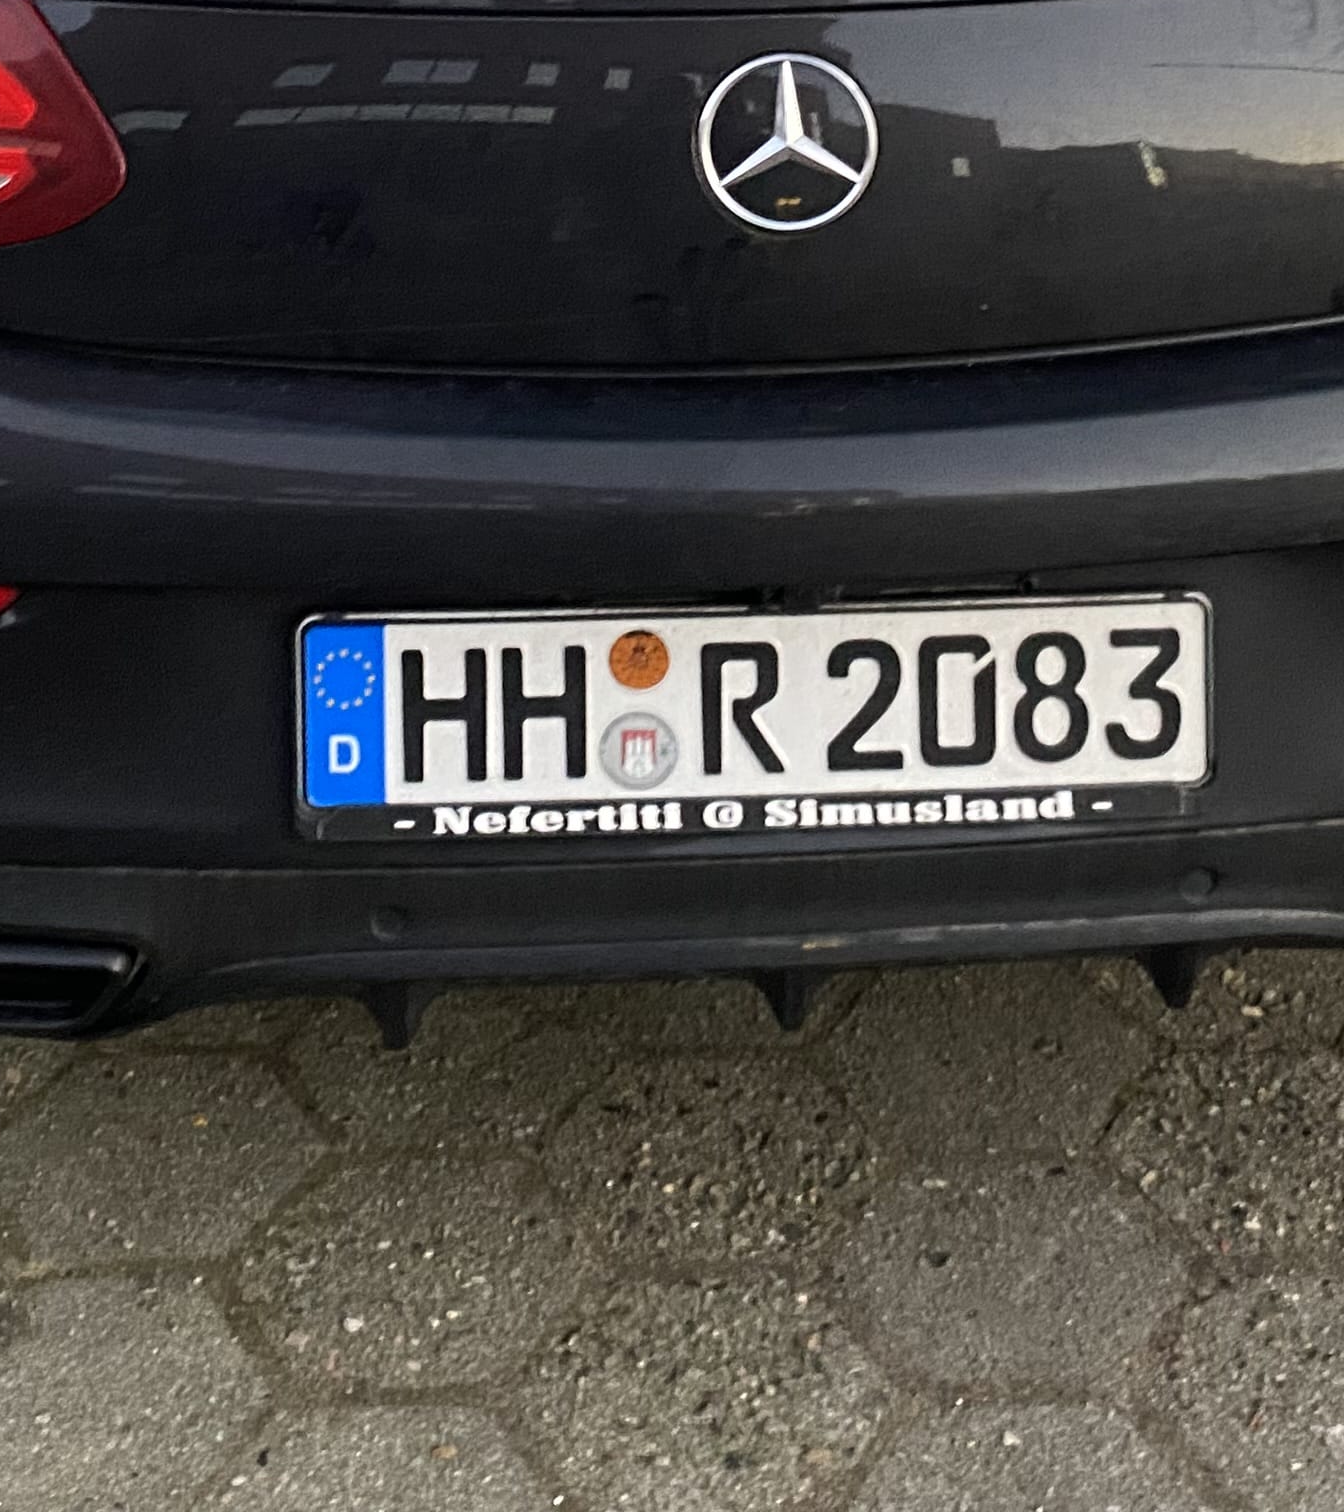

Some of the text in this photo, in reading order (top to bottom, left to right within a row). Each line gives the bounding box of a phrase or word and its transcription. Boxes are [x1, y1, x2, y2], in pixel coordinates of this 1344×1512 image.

[400, 628, 1182, 783] HH R 2083
[330, 736, 360, 774] D
[432, 803, 683, 835] Nefertiti
[703, 800, 743, 829] @
[764, 791, 1076, 828] Simusland
